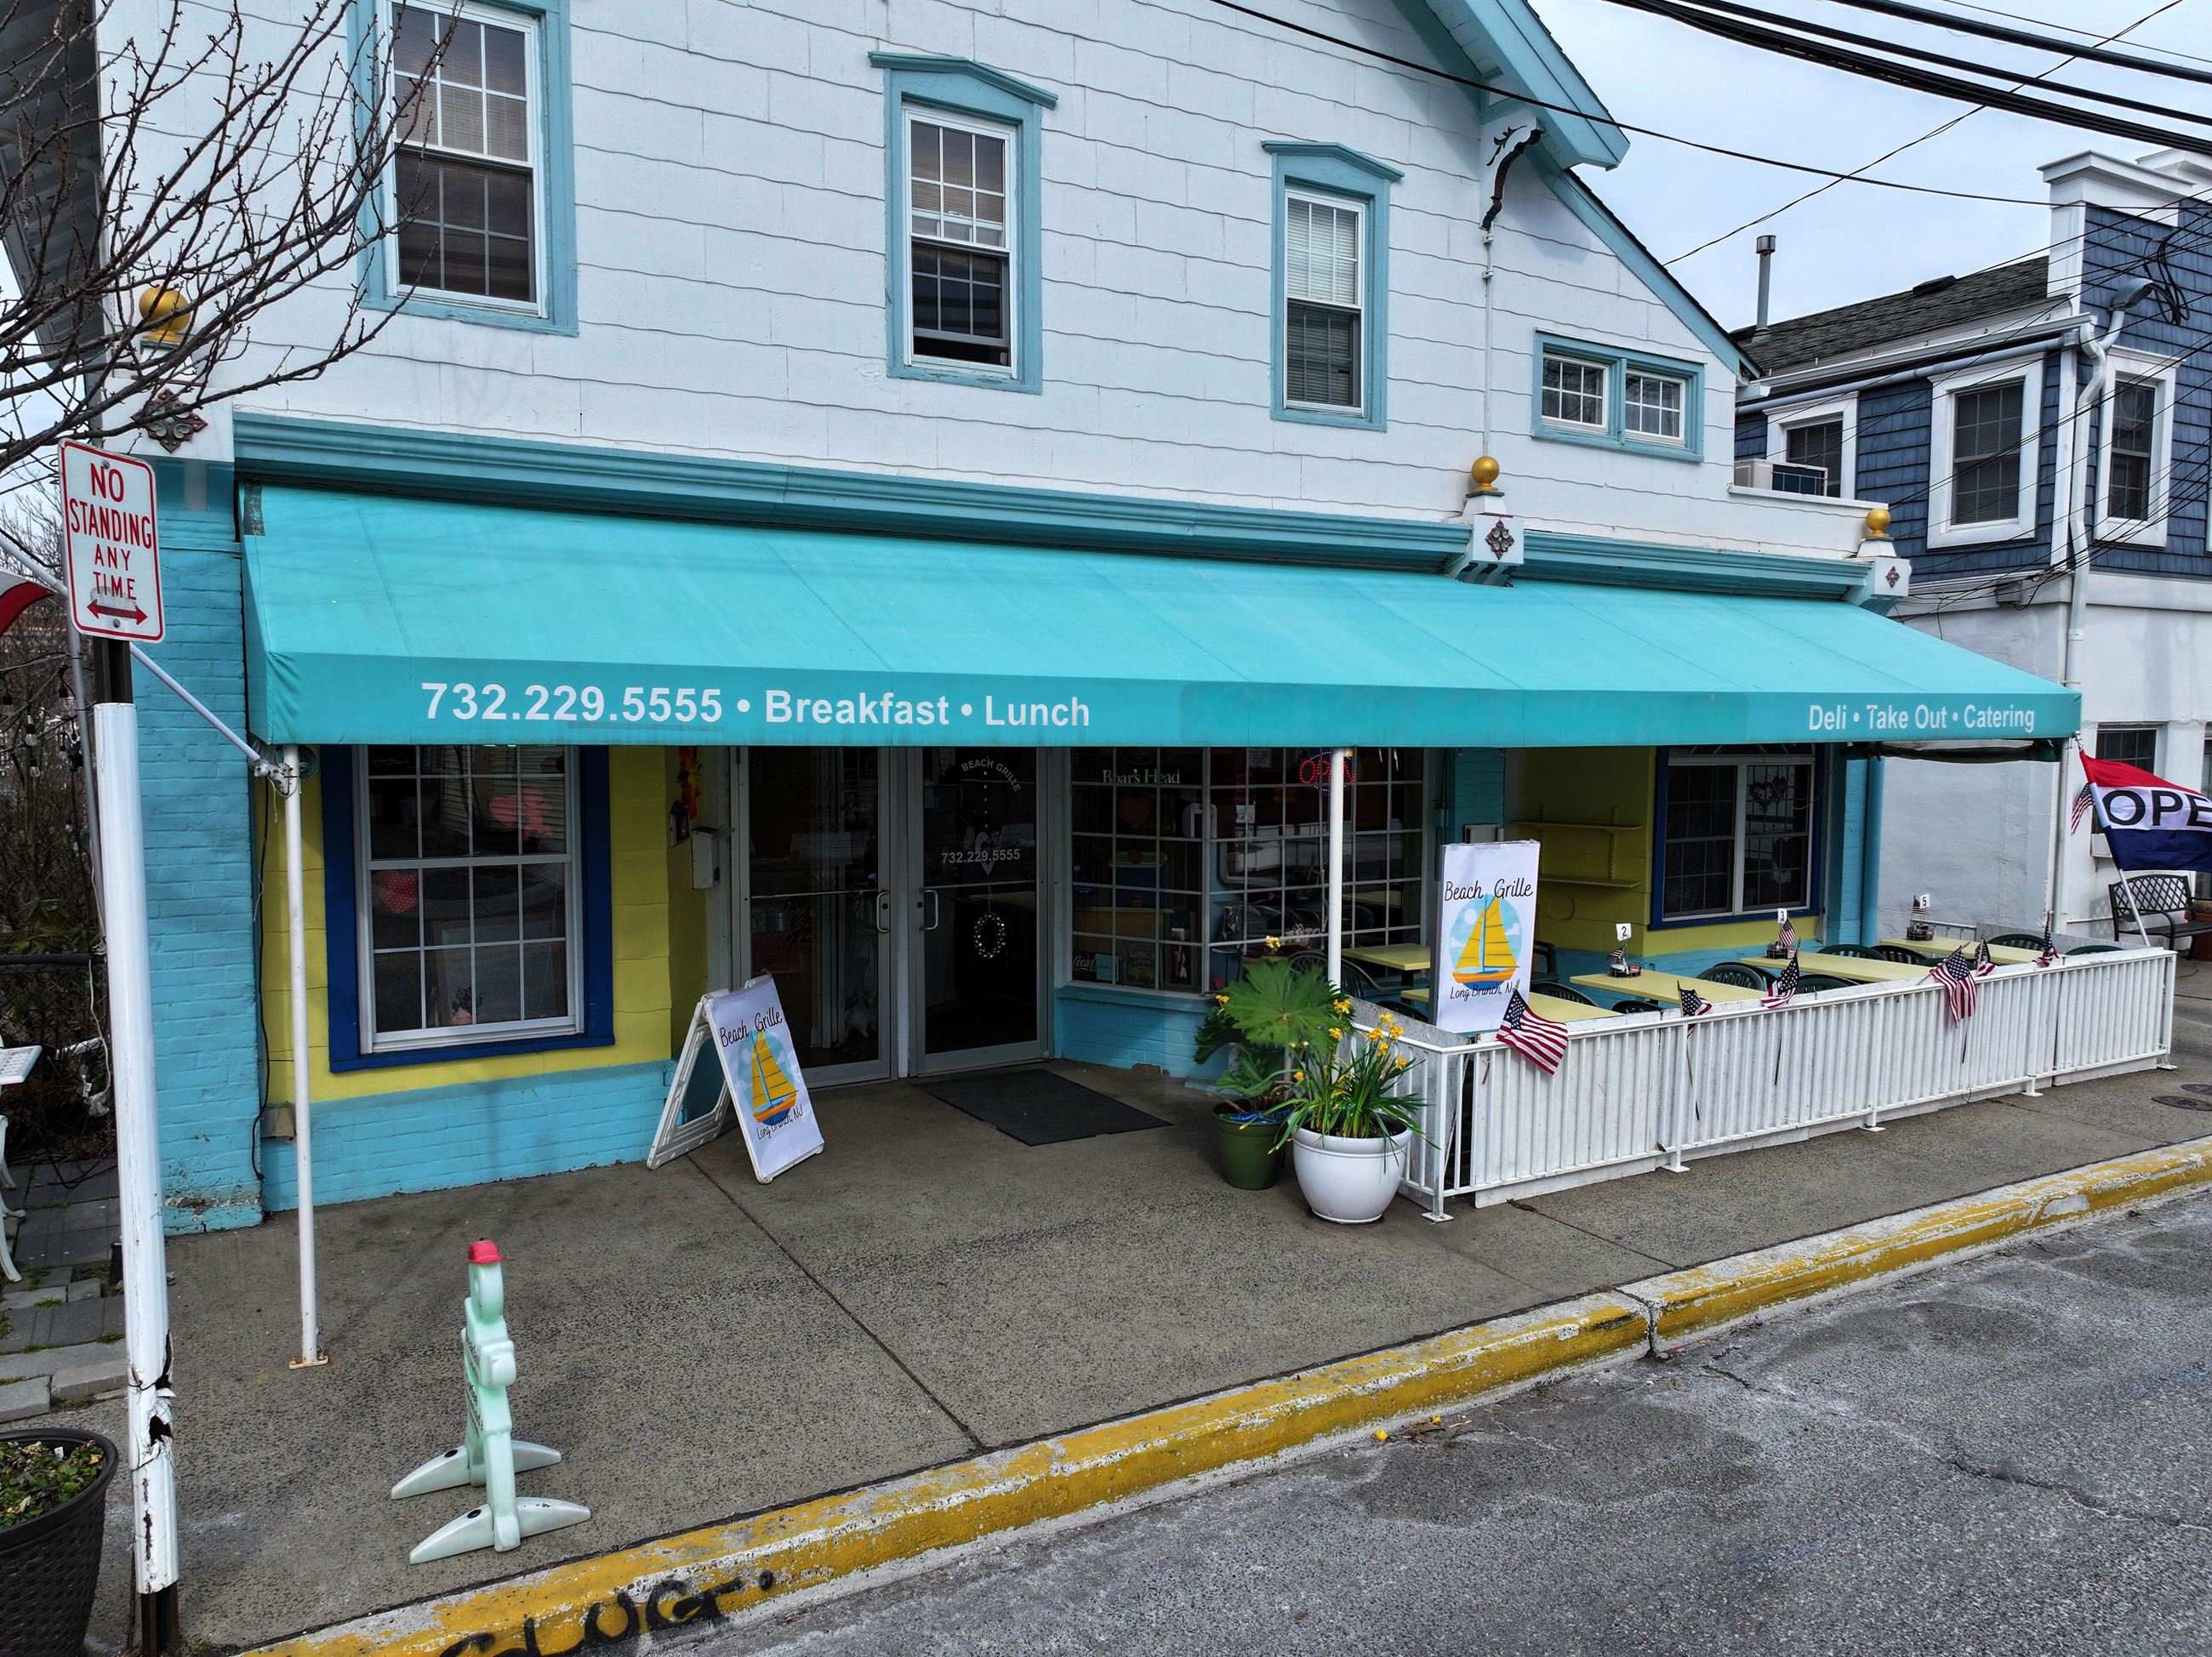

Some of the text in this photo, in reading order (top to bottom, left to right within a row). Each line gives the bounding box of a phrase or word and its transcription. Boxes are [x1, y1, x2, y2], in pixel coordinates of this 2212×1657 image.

[90, 463, 124, 503] NO
[69, 498, 152, 549] STANDING
[94, 544, 130, 571] ANY
[93, 572, 137, 601] TIME
[421, 682, 1090, 726] 732.229.5555 Breakfast Lunch
[1809, 703, 2036, 733] Deli Take Out Catering
[961, 756, 1022, 794] BEACH GRILLE
[1102, 766, 1182, 784] Boar's Head
[941, 848, 1021, 864] 732.229.5555
[1444, 877, 1534, 902] Beach Grille
[1922, 896, 1927, 907] 5
[1780, 910, 1785, 921] 3
[1622, 925, 1628, 937] 2
[1450, 987, 1470, 1001] Long
[1470, 982, 1502, 997] Branch,
[719, 1006, 783, 1048] Beach Grille
[755, 1127, 772, 1141] Long
[792, 1103, 804, 1120] NJ
